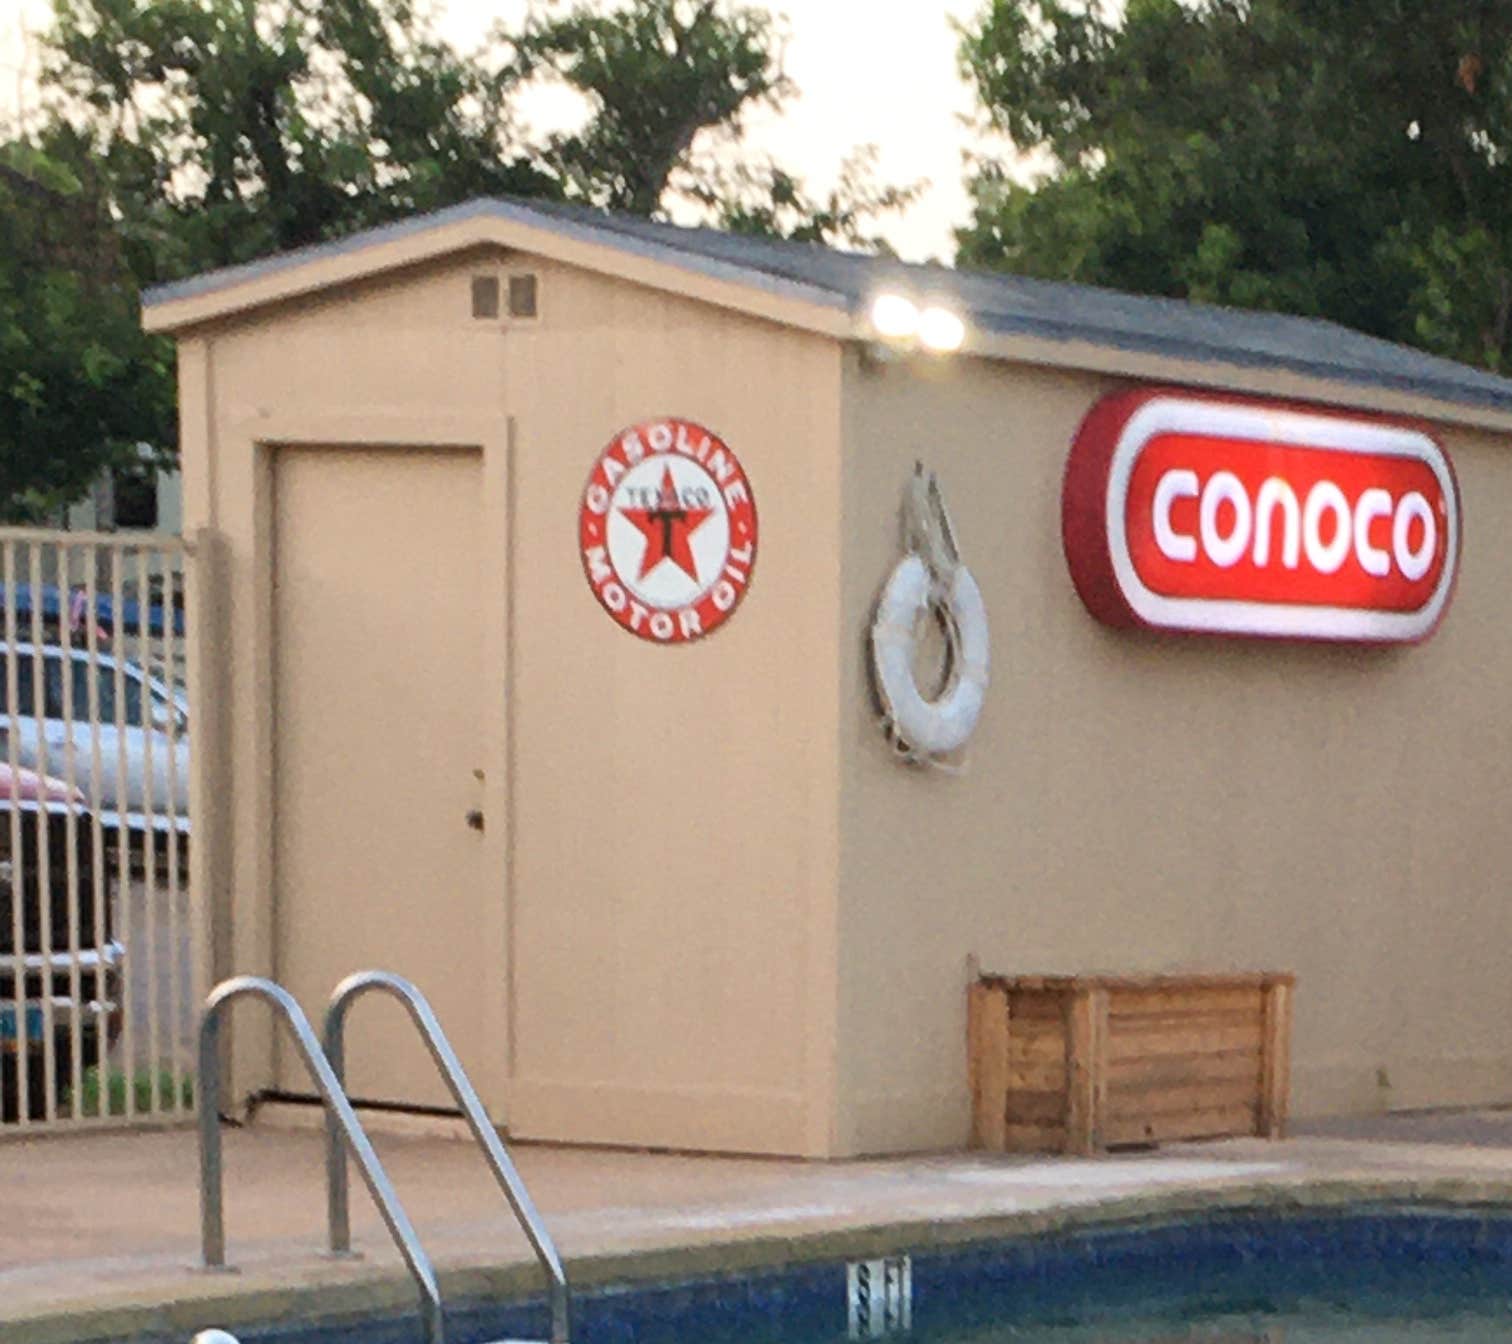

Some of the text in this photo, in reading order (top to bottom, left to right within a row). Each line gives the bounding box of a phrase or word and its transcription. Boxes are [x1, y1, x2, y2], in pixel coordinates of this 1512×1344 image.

[586, 423, 748, 514] GASOLINE
[1152, 469, 1437, 582] CONOCO
[584, 541, 752, 639] MOTOR OIL
